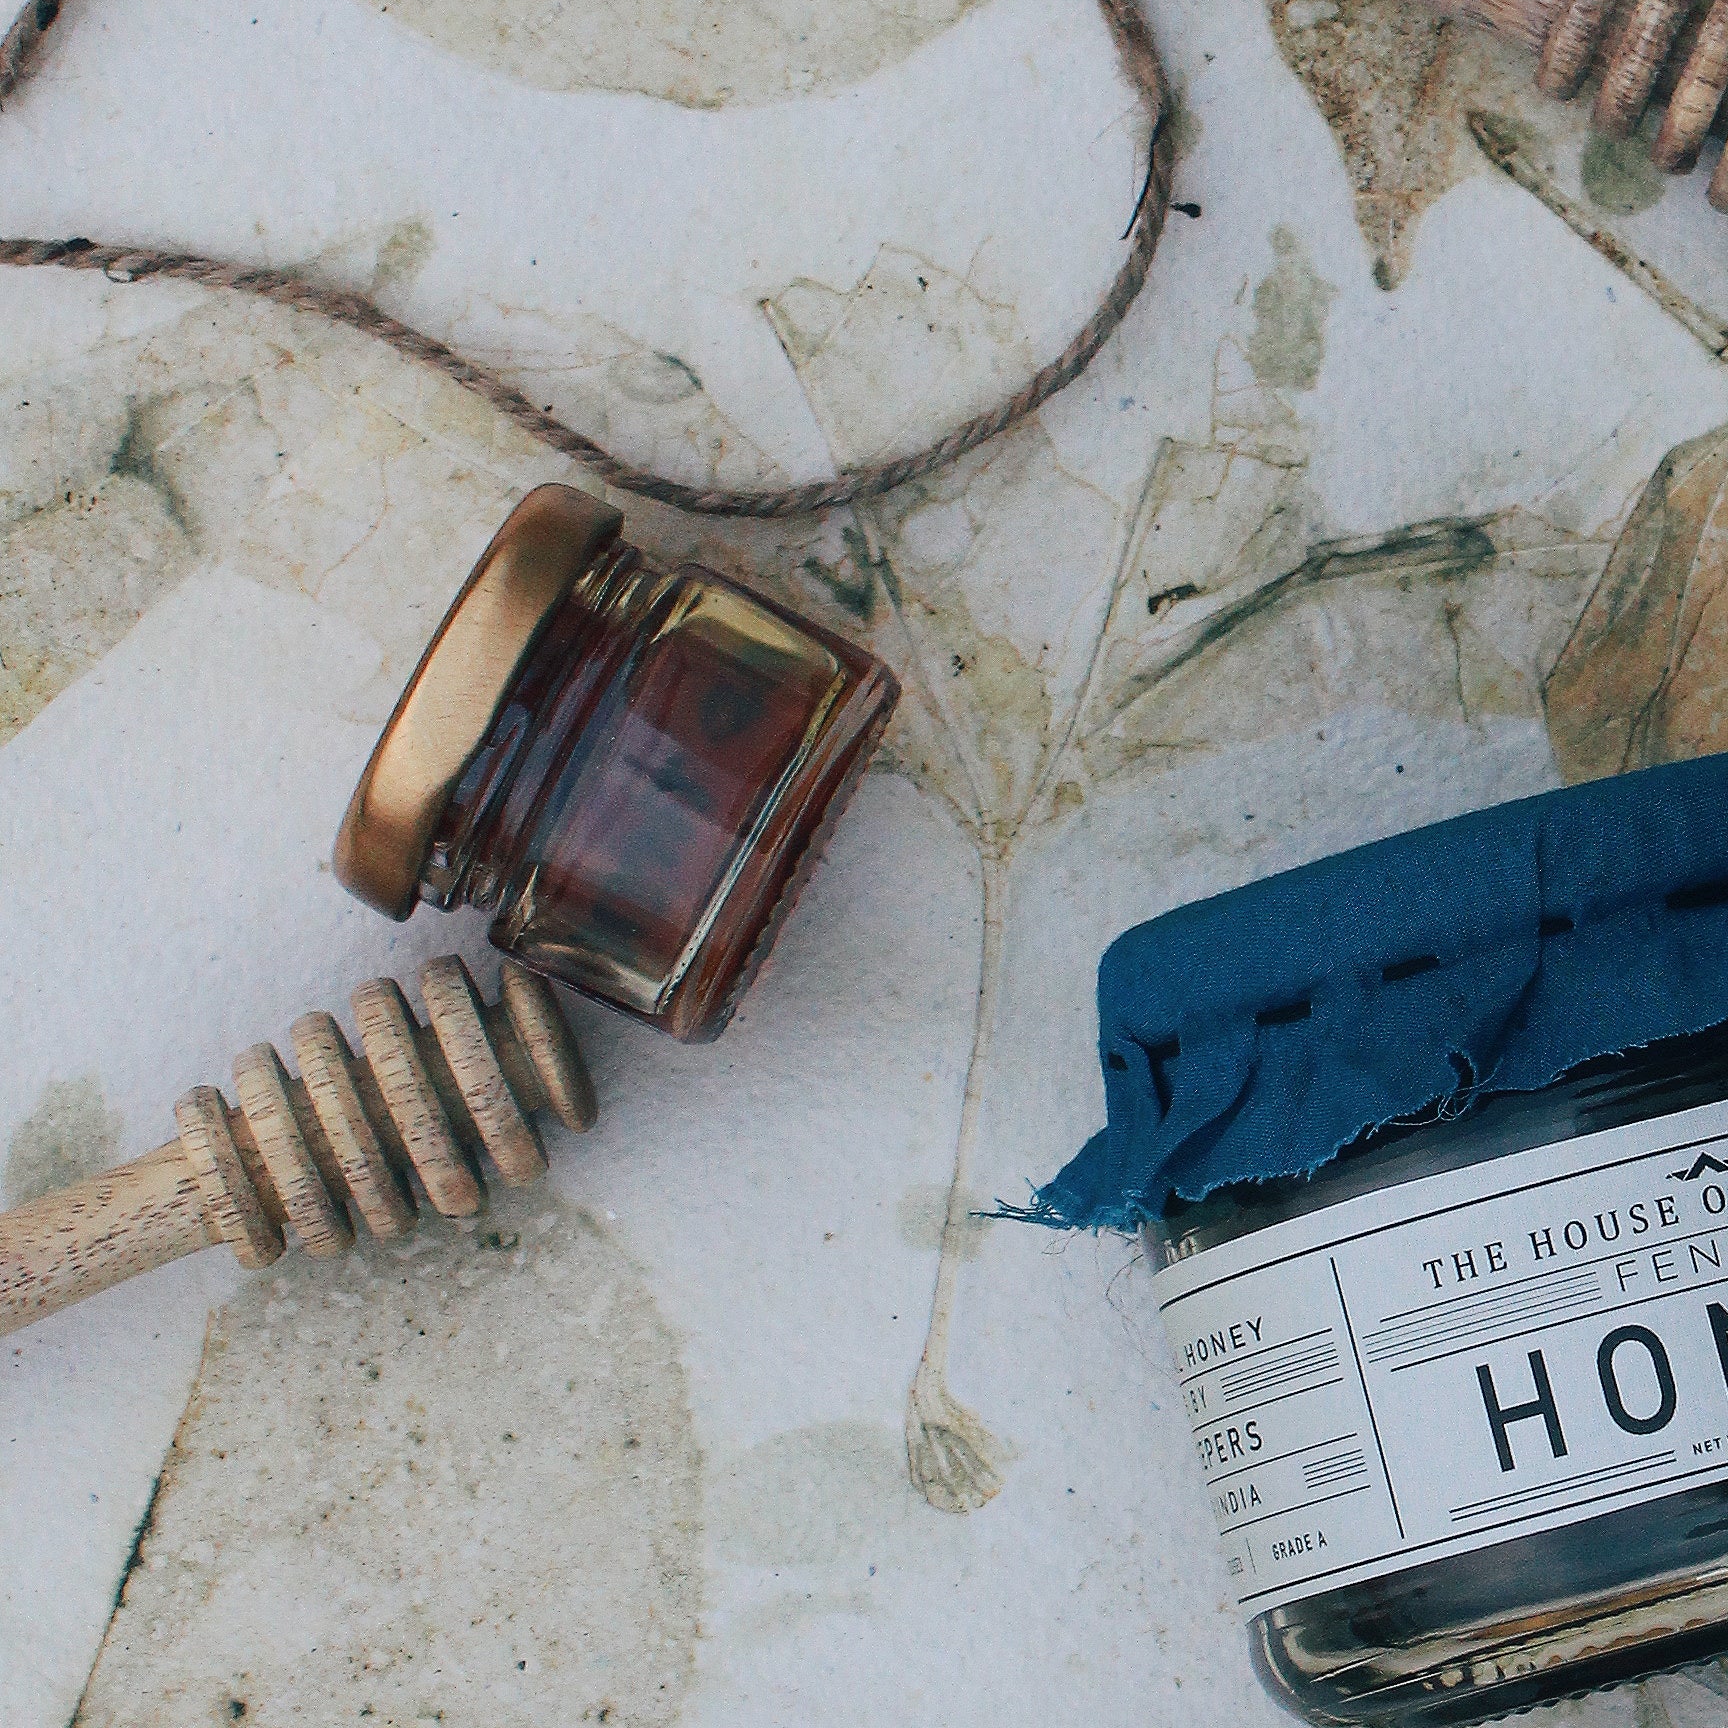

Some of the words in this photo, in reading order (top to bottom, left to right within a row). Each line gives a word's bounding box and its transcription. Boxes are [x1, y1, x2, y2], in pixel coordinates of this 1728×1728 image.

[1422, 1241, 1508, 1289] THE
[1528, 1195, 1680, 1261] HOUSE
[1183, 1315, 1263, 1368] HONEY
[1692, 1437, 1722, 1455] NET
[1271, 1533, 1314, 1561] GRADE
[1317, 1529, 1328, 1547] A
